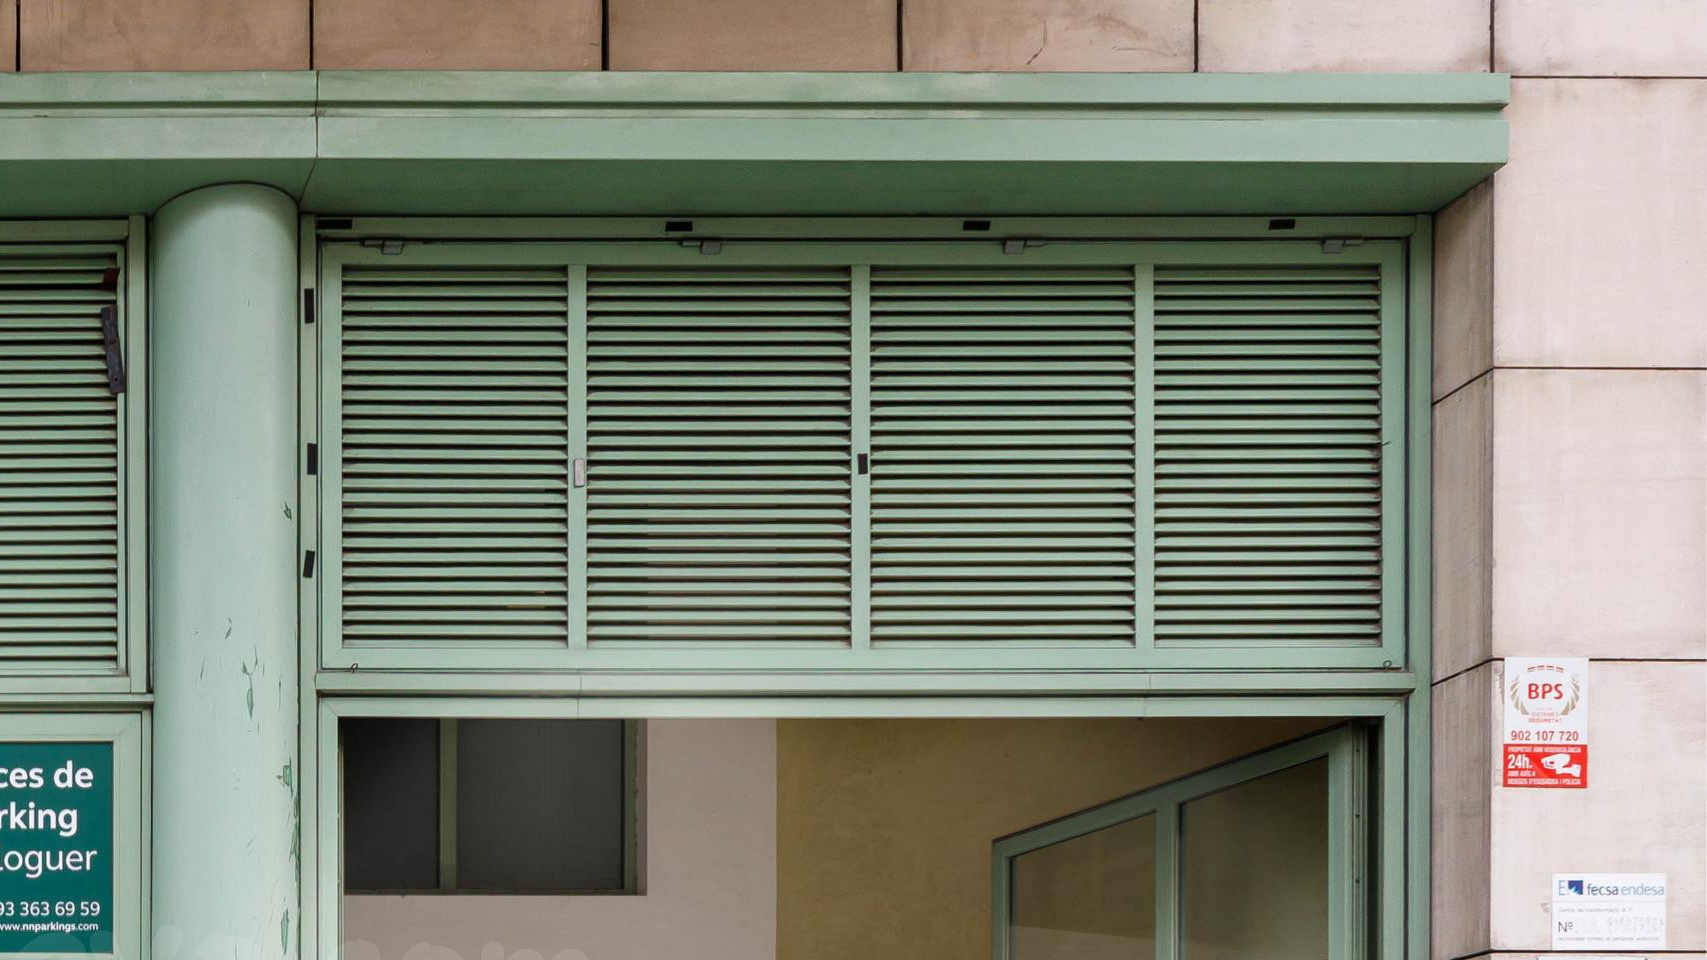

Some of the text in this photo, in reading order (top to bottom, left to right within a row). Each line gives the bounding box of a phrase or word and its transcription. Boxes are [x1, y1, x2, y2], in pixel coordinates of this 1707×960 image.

[1528, 683, 1563, 699] BPS
[1511, 731, 1579, 741] 902 107 720
[1508, 754, 1533, 769] 24h.
[53, 760, 94, 789] de
[1587, 883, 1619, 896] fecsa
[1621, 883, 1664, 896] endesa
[19, 901, 50, 916] 363
[54, 901, 75, 916] 69
[80, 901, 100, 916] 59
